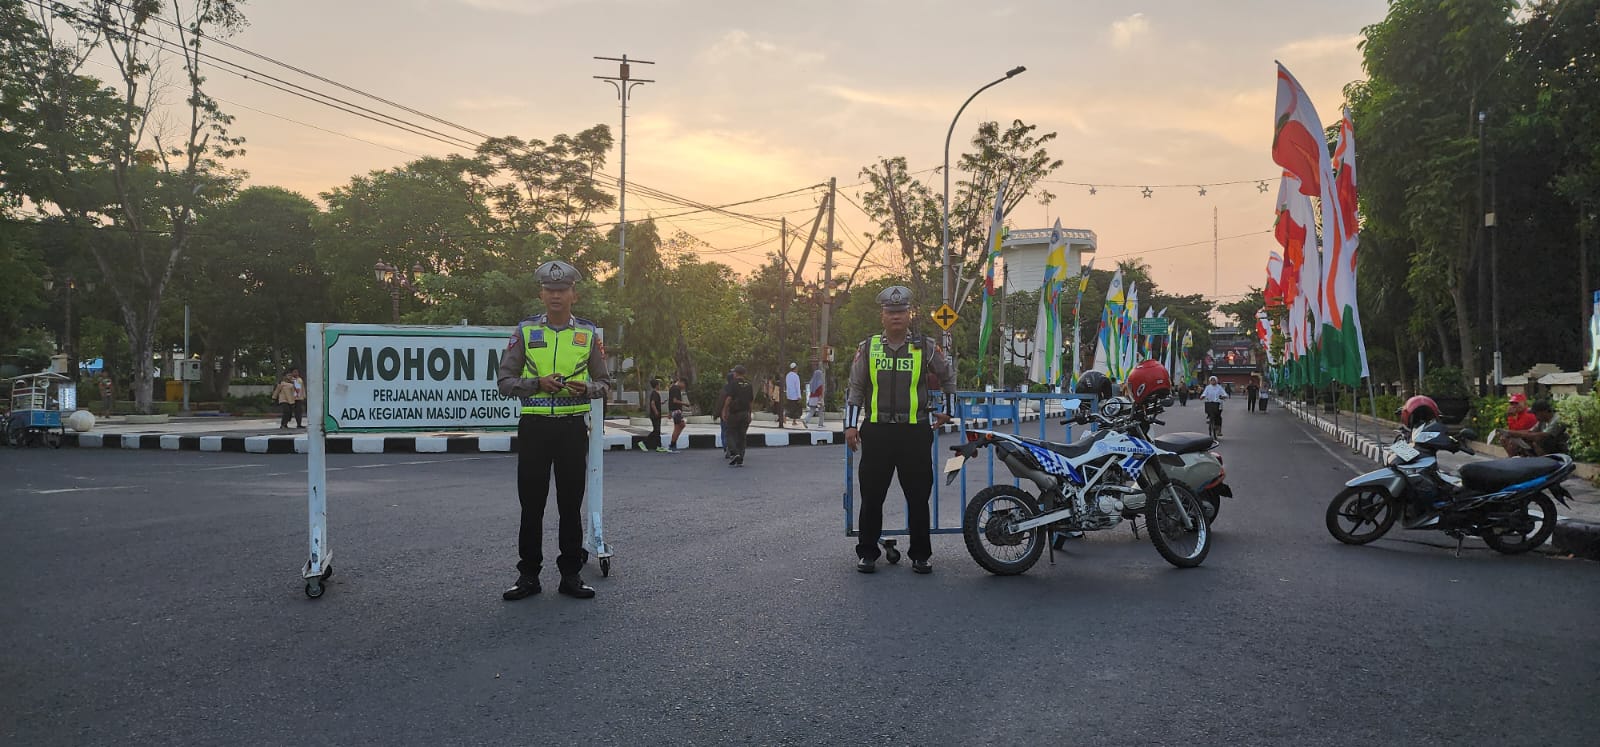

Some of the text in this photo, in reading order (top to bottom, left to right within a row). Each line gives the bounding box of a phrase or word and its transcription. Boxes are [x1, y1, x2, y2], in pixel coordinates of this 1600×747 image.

[346, 347, 475, 381] MOHON
[875, 358, 914, 370] POLISI
[373, 389, 442, 402] PERJALANAN
[446, 389, 478, 402] ANDA
[341, 408, 365, 420] ADA
[369, 407, 424, 420] KEGIATAN
[426, 407, 467, 420] MASJID
[470, 407, 513, 419] AGUNG
